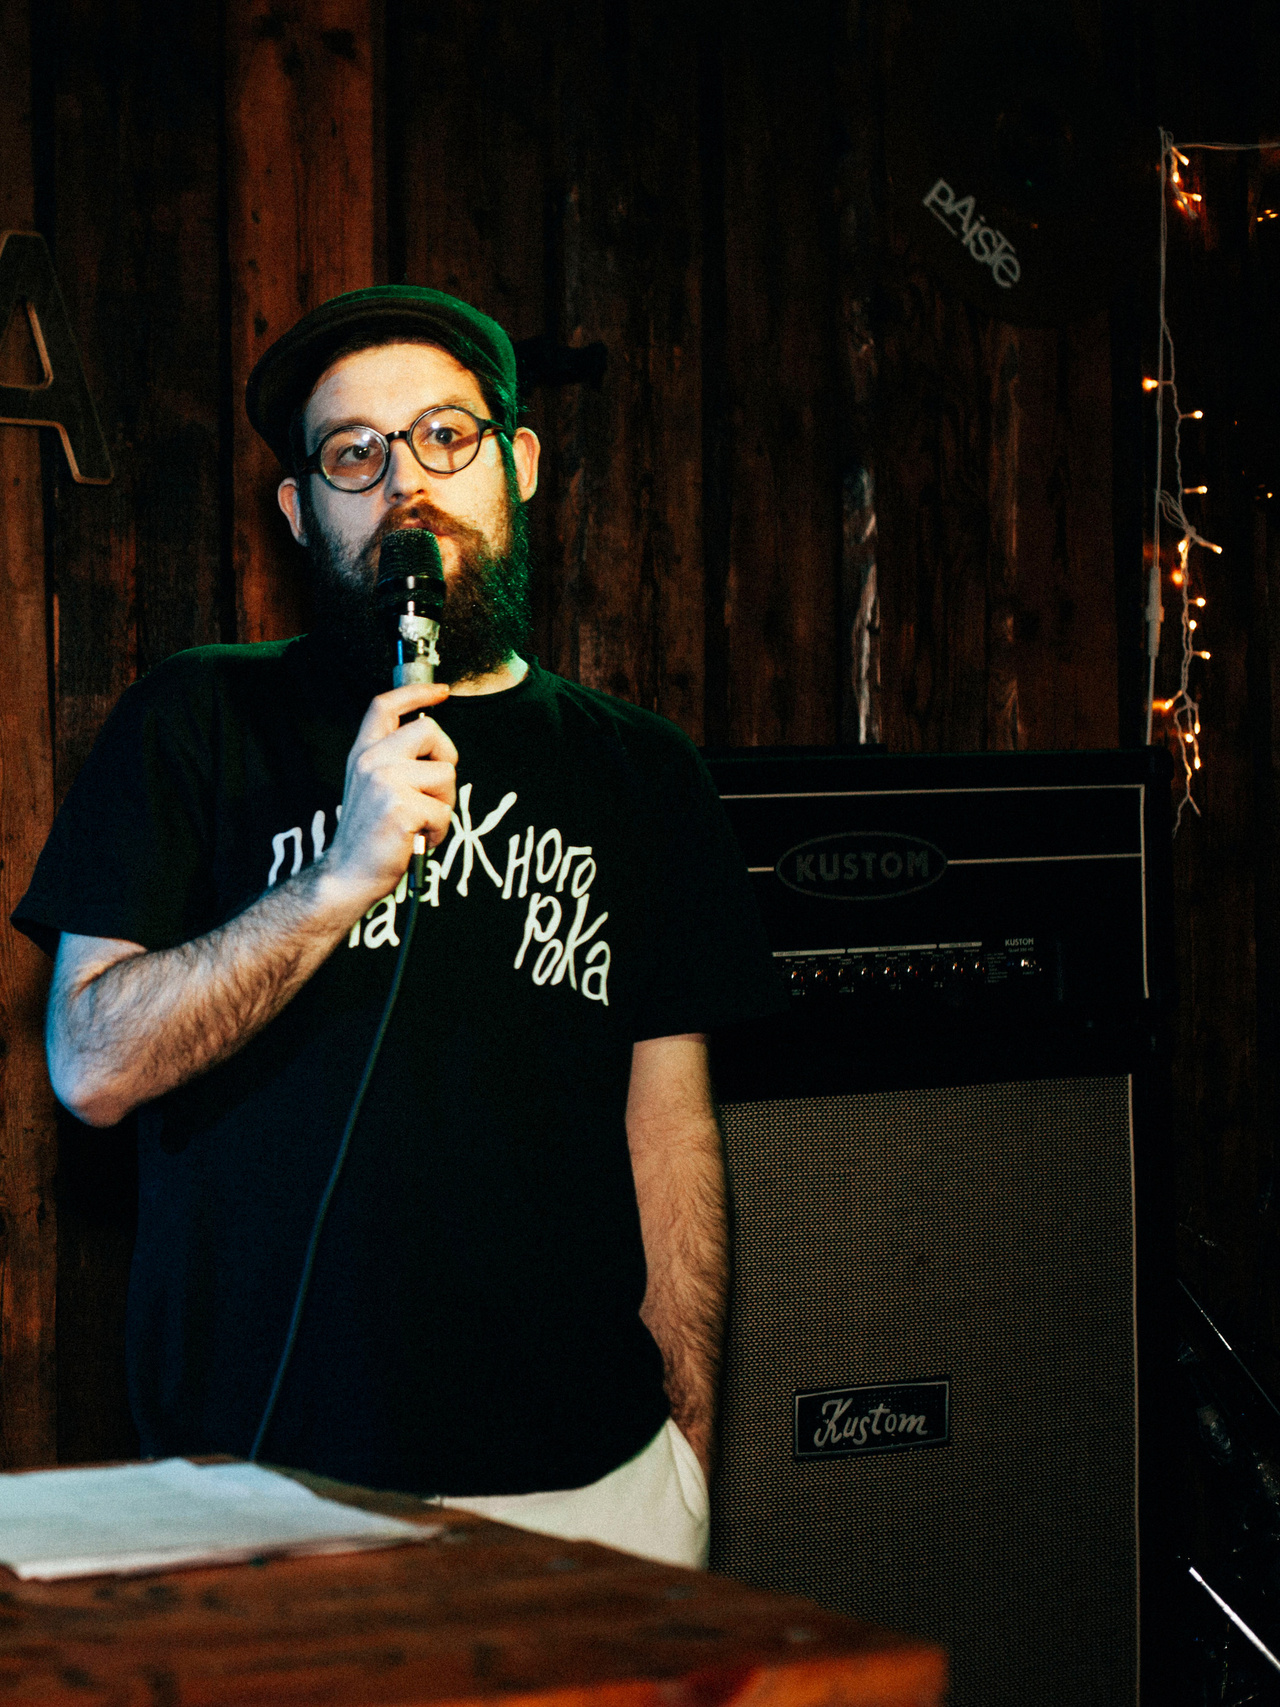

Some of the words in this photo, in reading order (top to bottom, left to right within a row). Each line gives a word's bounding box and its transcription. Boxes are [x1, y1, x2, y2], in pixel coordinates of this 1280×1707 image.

[795, 849, 930, 882] KUSTOM
[513, 892, 611, 1007] рока
[1004, 937, 1035, 947] KUSTOM
[813, 1397, 928, 1447] Kustom
